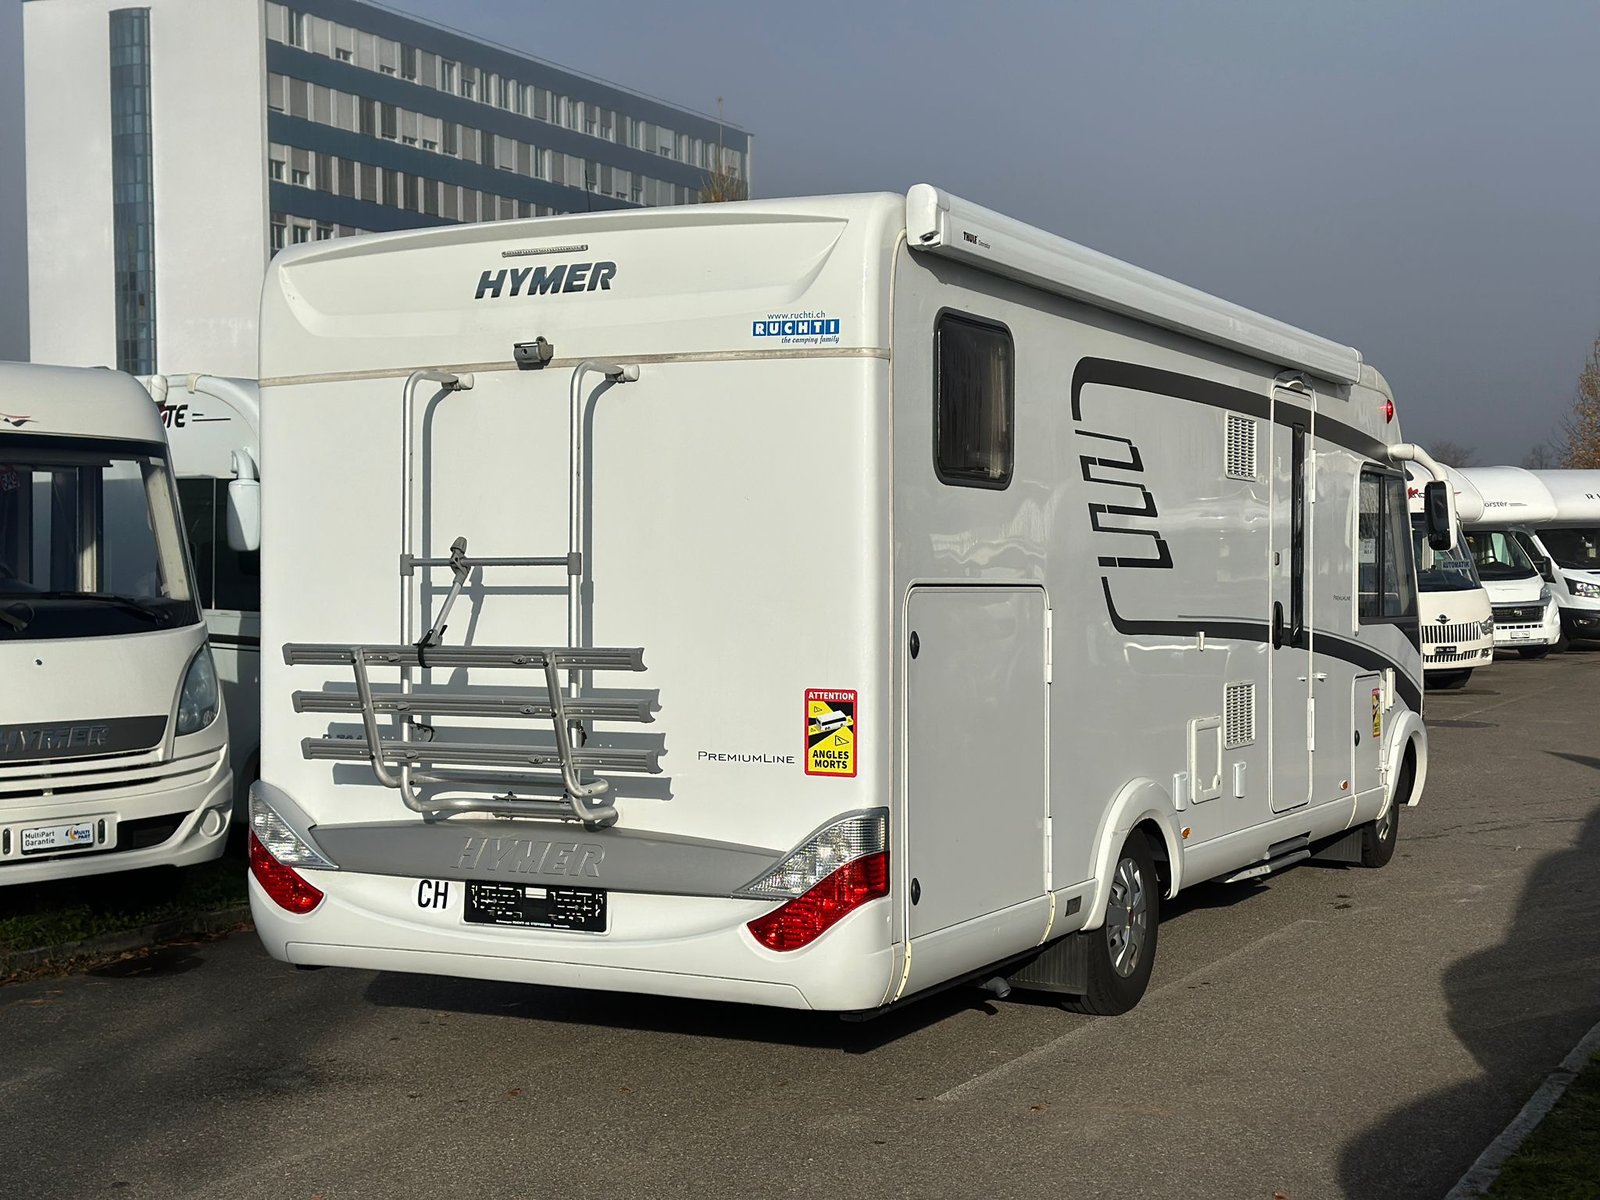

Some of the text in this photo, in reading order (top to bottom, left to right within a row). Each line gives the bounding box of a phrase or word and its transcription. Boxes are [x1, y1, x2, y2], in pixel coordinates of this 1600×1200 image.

[474, 261, 617, 299] HYMER
[767, 311, 826, 320] www.ruchti.ch
[753, 320, 838, 335] RUCHTI
[792, 336, 818, 344] camping
[819, 335, 840, 344] family
[808, 691, 855, 700] ATTENTION
[812, 749, 850, 760] ANGLES
[814, 759, 848, 769] MORTS
[25, 831, 56, 840] MultiPart
[25, 838, 56, 847] Garantie
[450, 836, 606, 877] HYMER
[417, 879, 449, 909] CH
